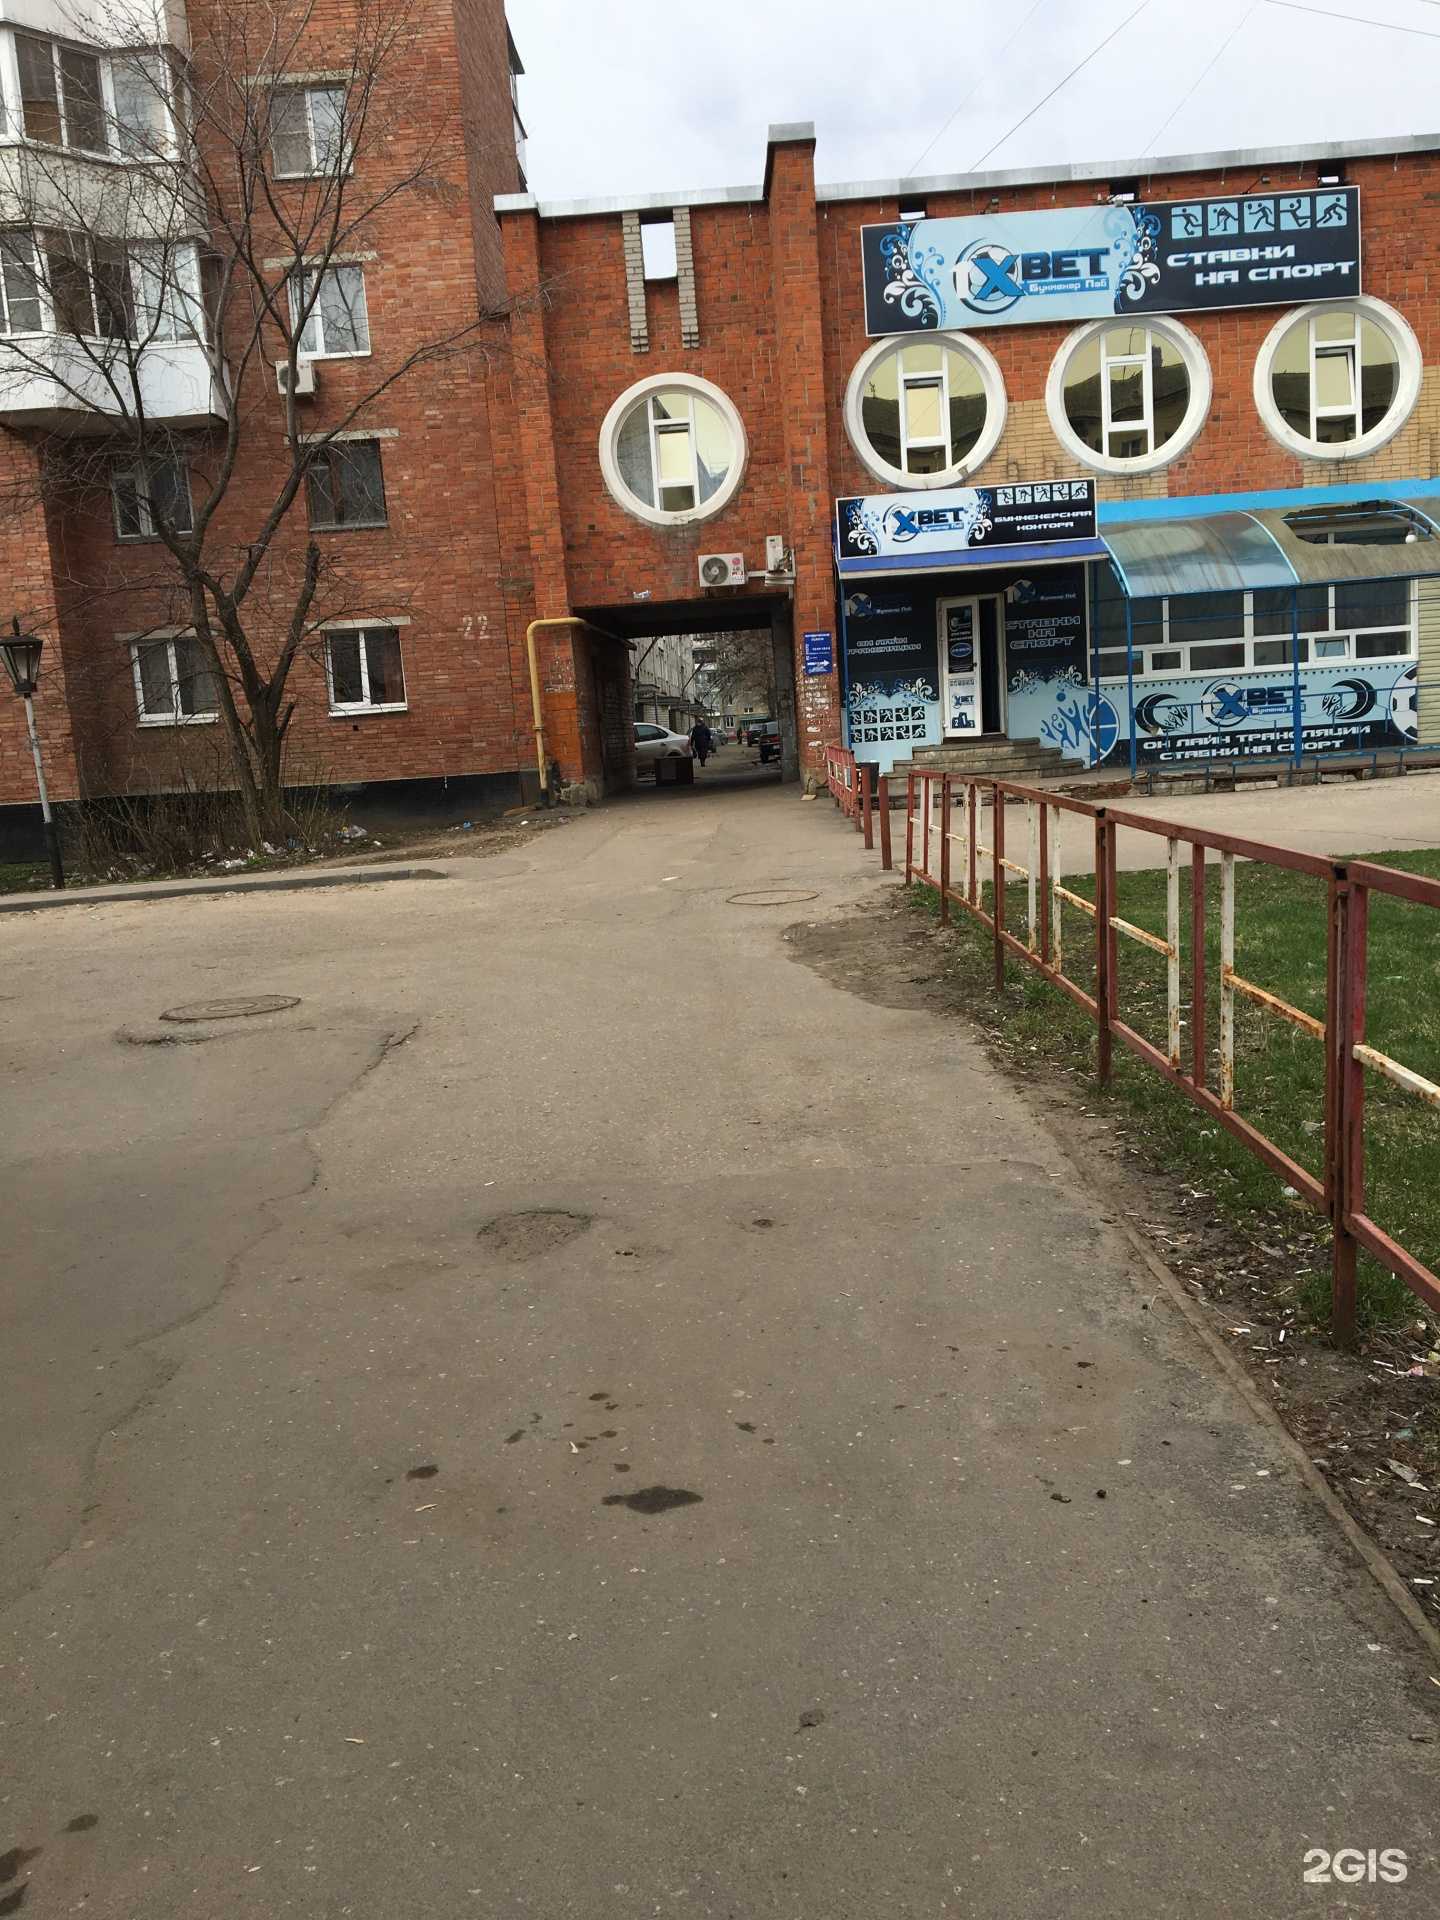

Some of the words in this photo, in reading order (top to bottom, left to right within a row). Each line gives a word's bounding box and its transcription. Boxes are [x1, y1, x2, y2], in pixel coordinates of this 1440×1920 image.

[1166, 245, 1296, 268] СТАВКИ
[1194, 270, 1240, 286] НА
[1248, 261, 1357, 281] СПОРТ
[1016, 522, 1074, 531] КОНТОРА
[1027, 628, 1056, 638] НА
[1009, 636, 1076, 649] СПОРТ
[1143, 741, 1170, 750] ОН
[1175, 733, 1231, 748] ЛАЙН
[1159, 749, 1239, 761] СТАВКИ
[1243, 745, 1272, 753] НА
